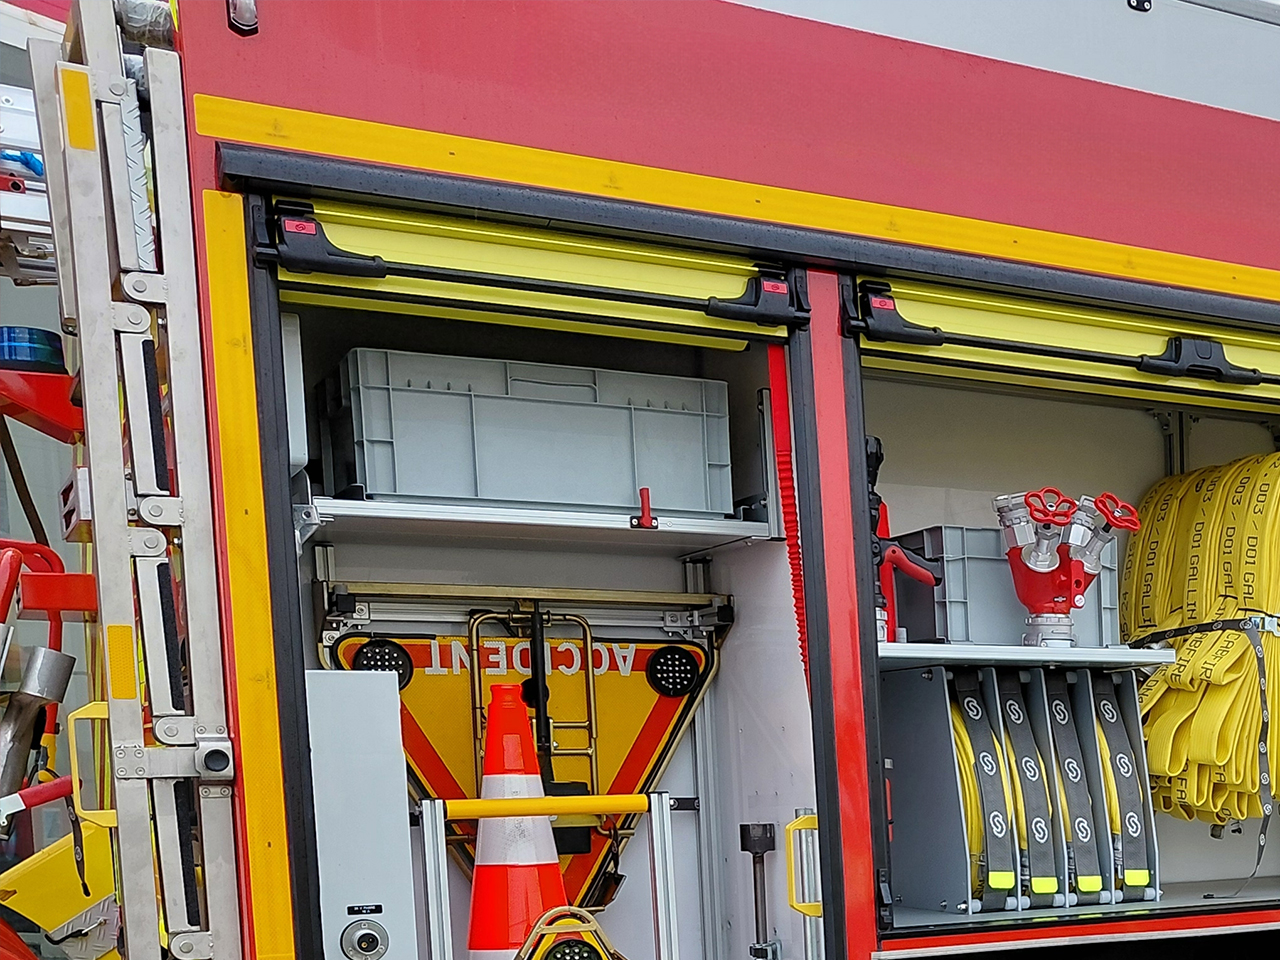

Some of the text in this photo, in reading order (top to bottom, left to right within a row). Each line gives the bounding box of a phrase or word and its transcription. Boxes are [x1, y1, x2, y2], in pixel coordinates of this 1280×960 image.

[1156, 493, 1173, 522] 003
[1231, 476, 1251, 506] 003
[1253, 483, 1270, 515] 003
[1140, 572, 1154, 631] GALLI
[1186, 554, 1200, 620] GALLIN
[1242, 572, 1256, 617] GAL
[424, 640, 636, 676] ACCIDENT
[1170, 632, 1208, 685] ABFIRE
[1199, 632, 1241, 683] CABFIR
